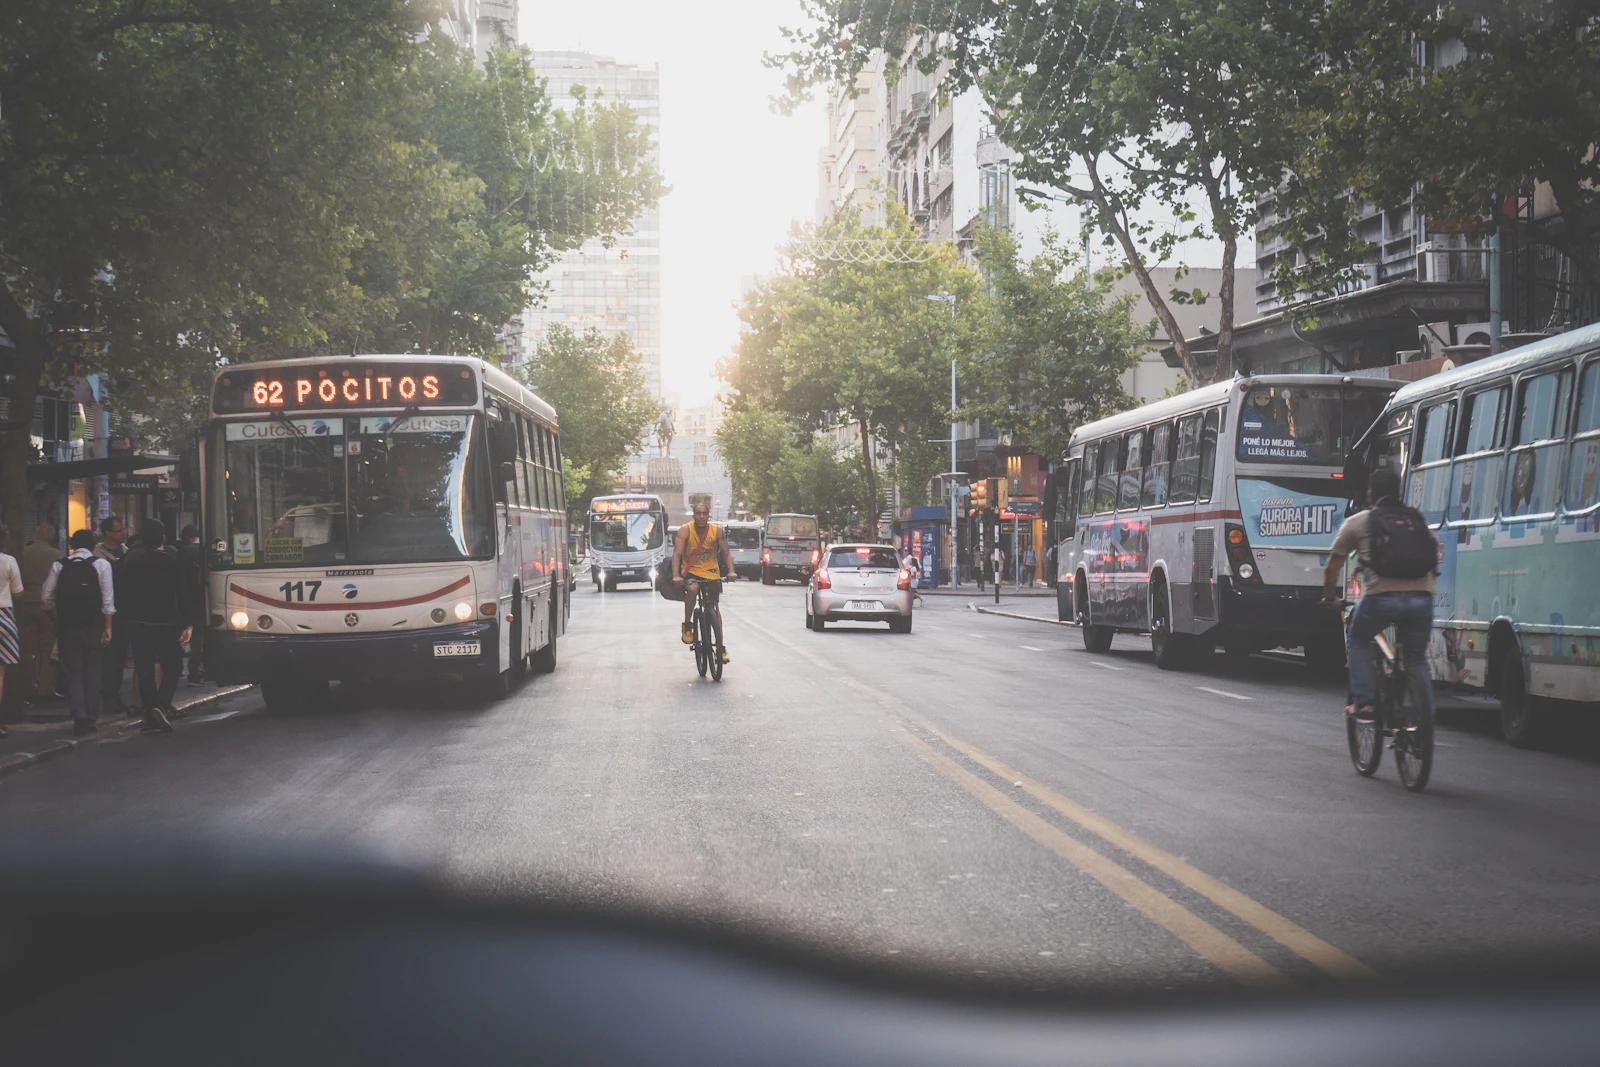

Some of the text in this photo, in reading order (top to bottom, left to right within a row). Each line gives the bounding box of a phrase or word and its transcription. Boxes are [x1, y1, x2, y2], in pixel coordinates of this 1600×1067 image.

[253, 375, 439, 404] 62 POCITOS
[241, 420, 308, 439] Cutcsa
[1243, 437, 1297, 448] PONÉ LO MEJOR.
[1248, 447, 1309, 458] LLEGÁ MÁS LEJOS.
[1260, 507, 1302, 523] AURORA
[1303, 505, 1336, 534] HIT
[1259, 521, 1302, 536] SUMMER
[279, 581, 322, 602] 117
[436, 645, 478, 655] STC 2117
